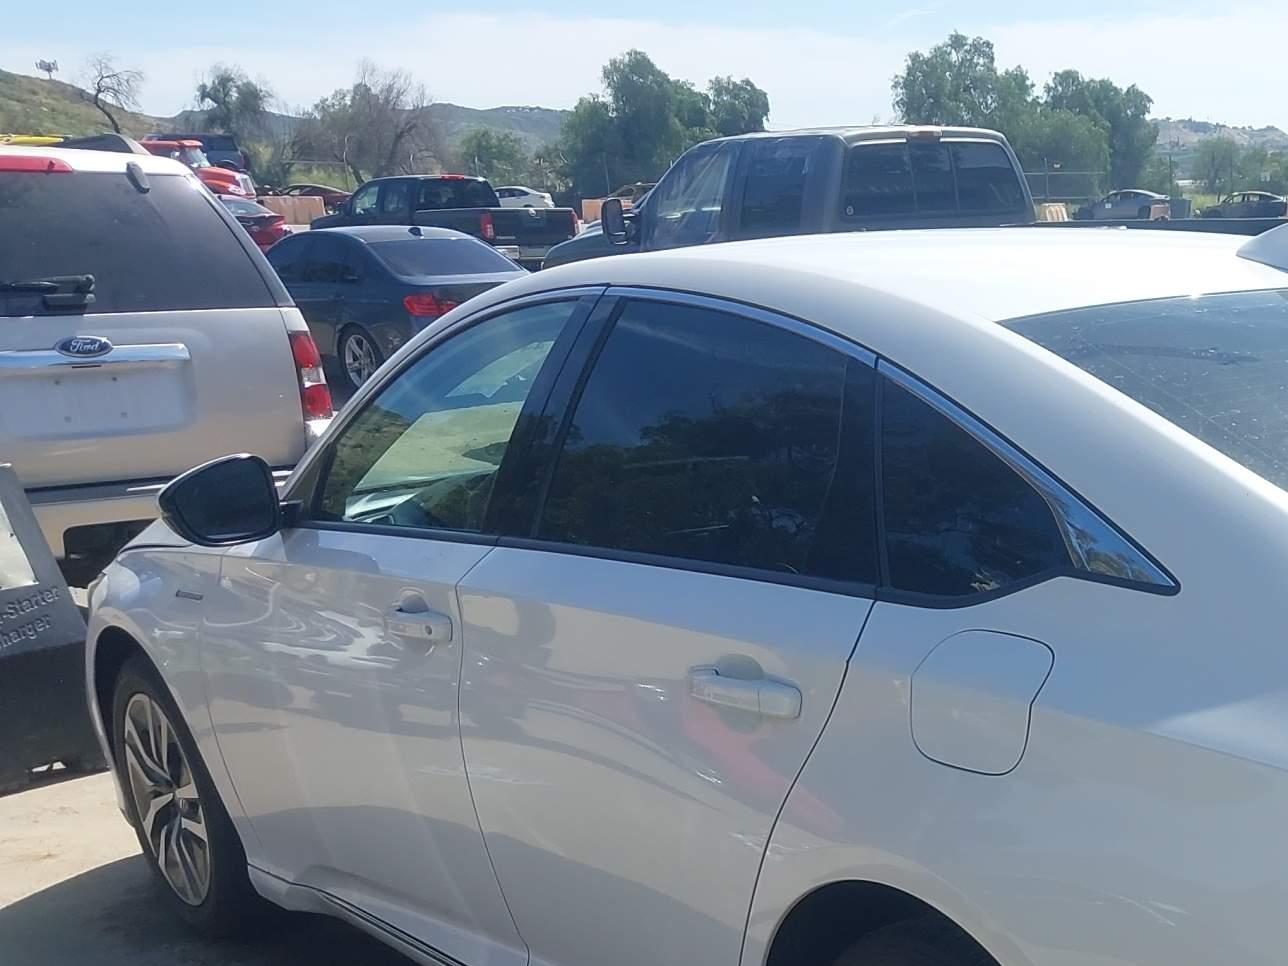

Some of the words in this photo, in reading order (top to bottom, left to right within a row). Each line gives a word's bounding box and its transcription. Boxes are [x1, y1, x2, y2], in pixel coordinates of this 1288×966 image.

[70, 339, 101, 352] Ford
[0, 587, 60, 621] -Starter
[0, 614, 51, 648] harger
